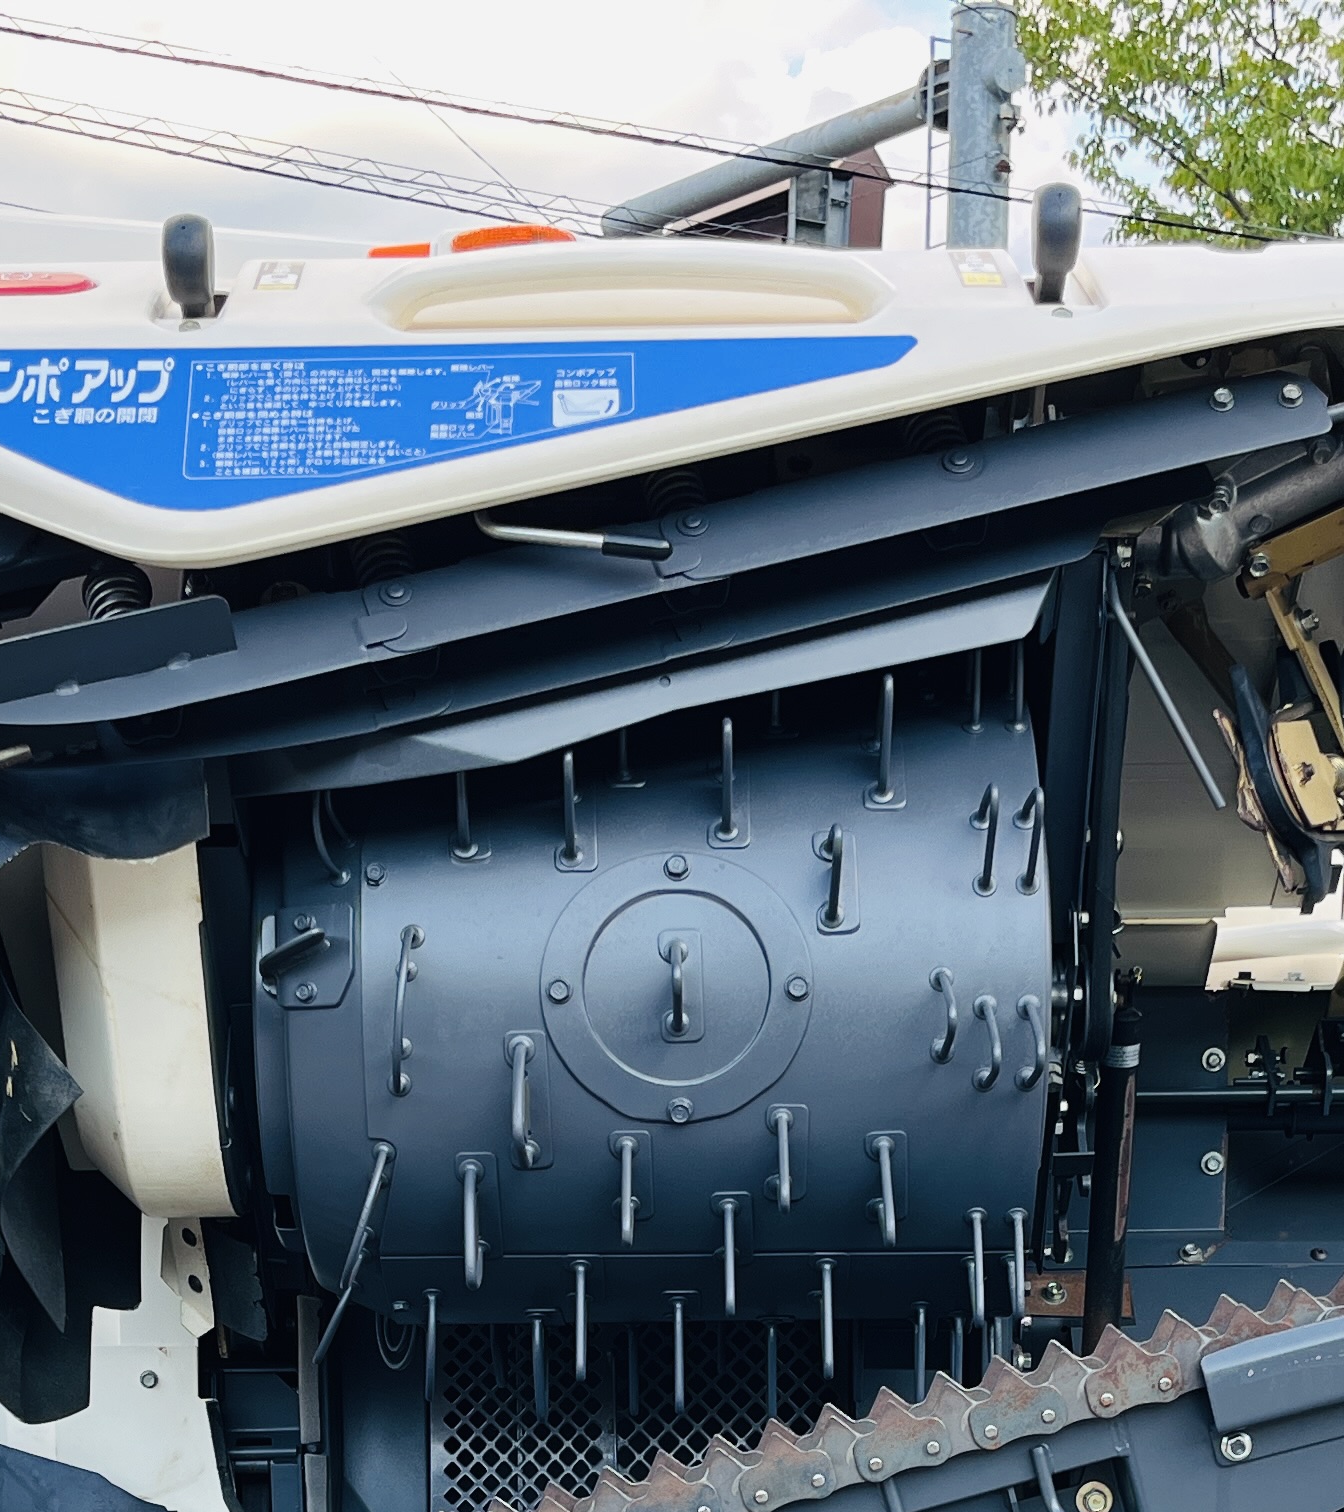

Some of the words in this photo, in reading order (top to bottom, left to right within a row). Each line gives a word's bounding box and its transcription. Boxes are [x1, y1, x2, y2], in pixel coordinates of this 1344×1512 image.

[32, 406, 158, 424] こぎ胴の開閉
